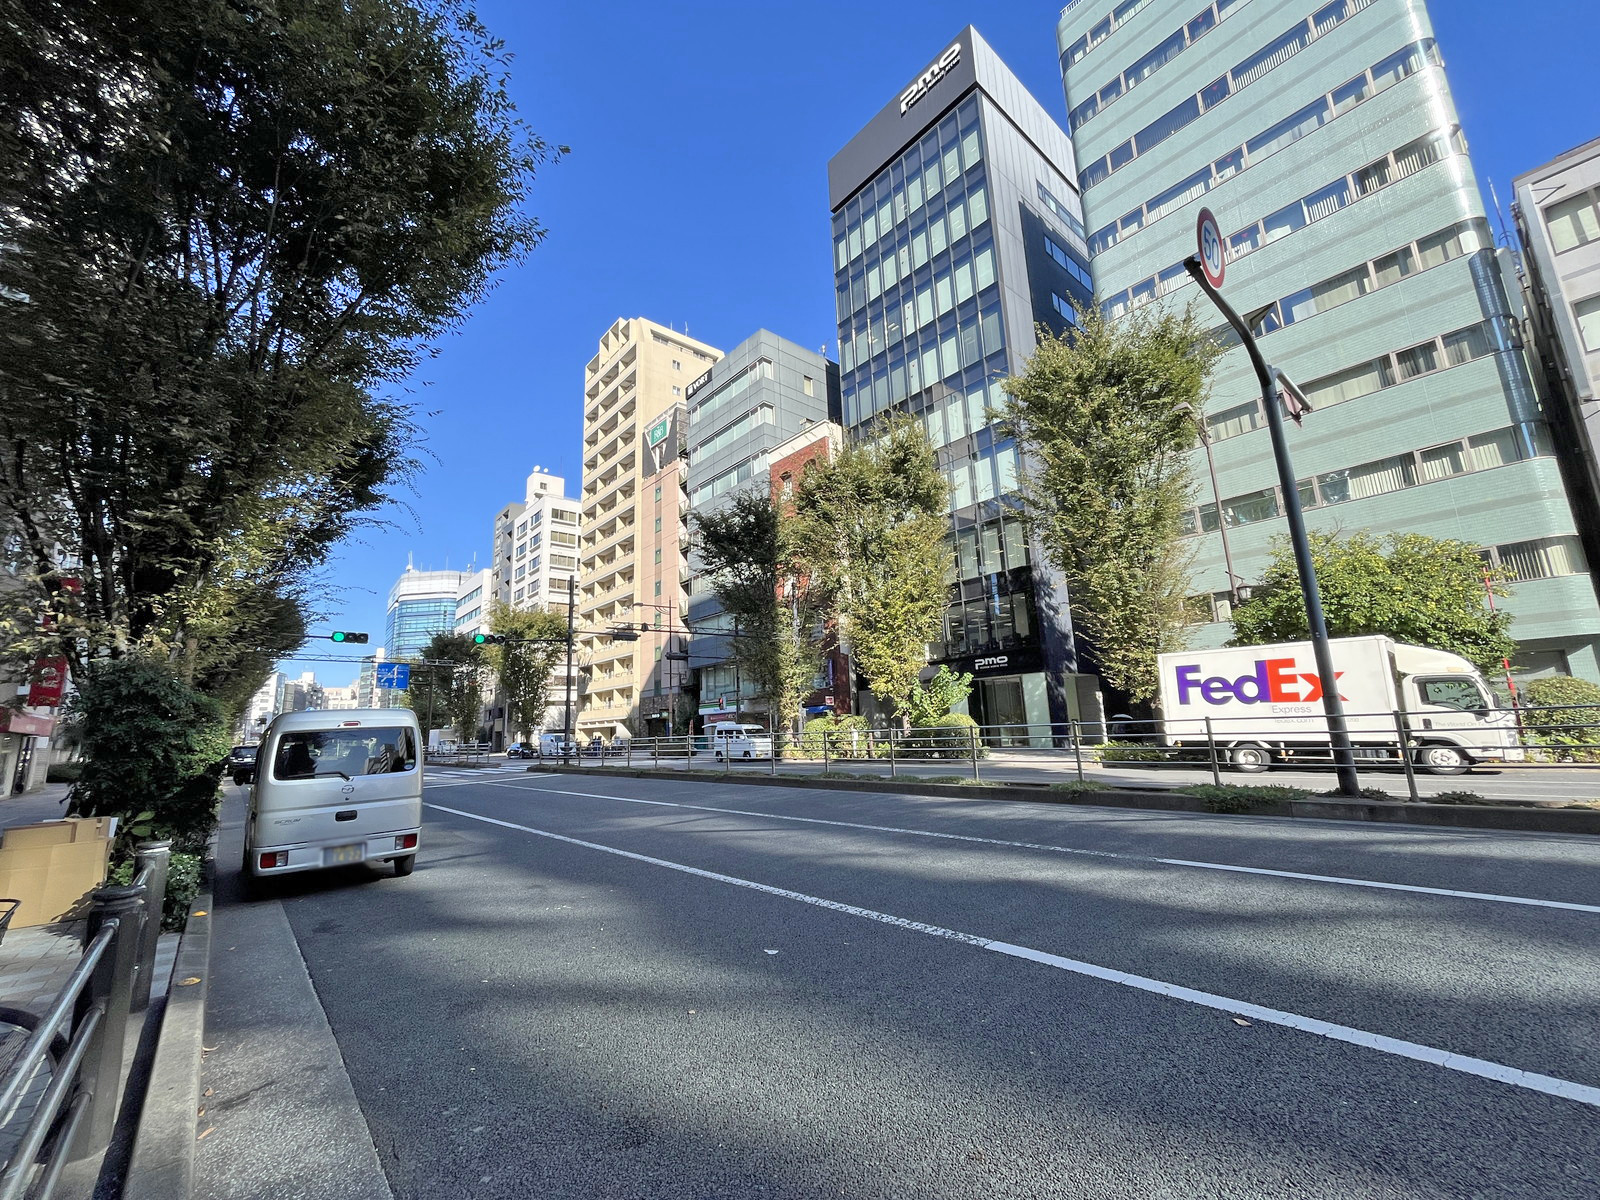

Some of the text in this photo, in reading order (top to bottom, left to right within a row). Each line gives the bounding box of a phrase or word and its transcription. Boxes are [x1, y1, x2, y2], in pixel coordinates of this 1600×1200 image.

[1203, 225, 1220, 271] 50
[1175, 658, 1350, 705] FedEx
[1271, 705, 1312, 715] Express
